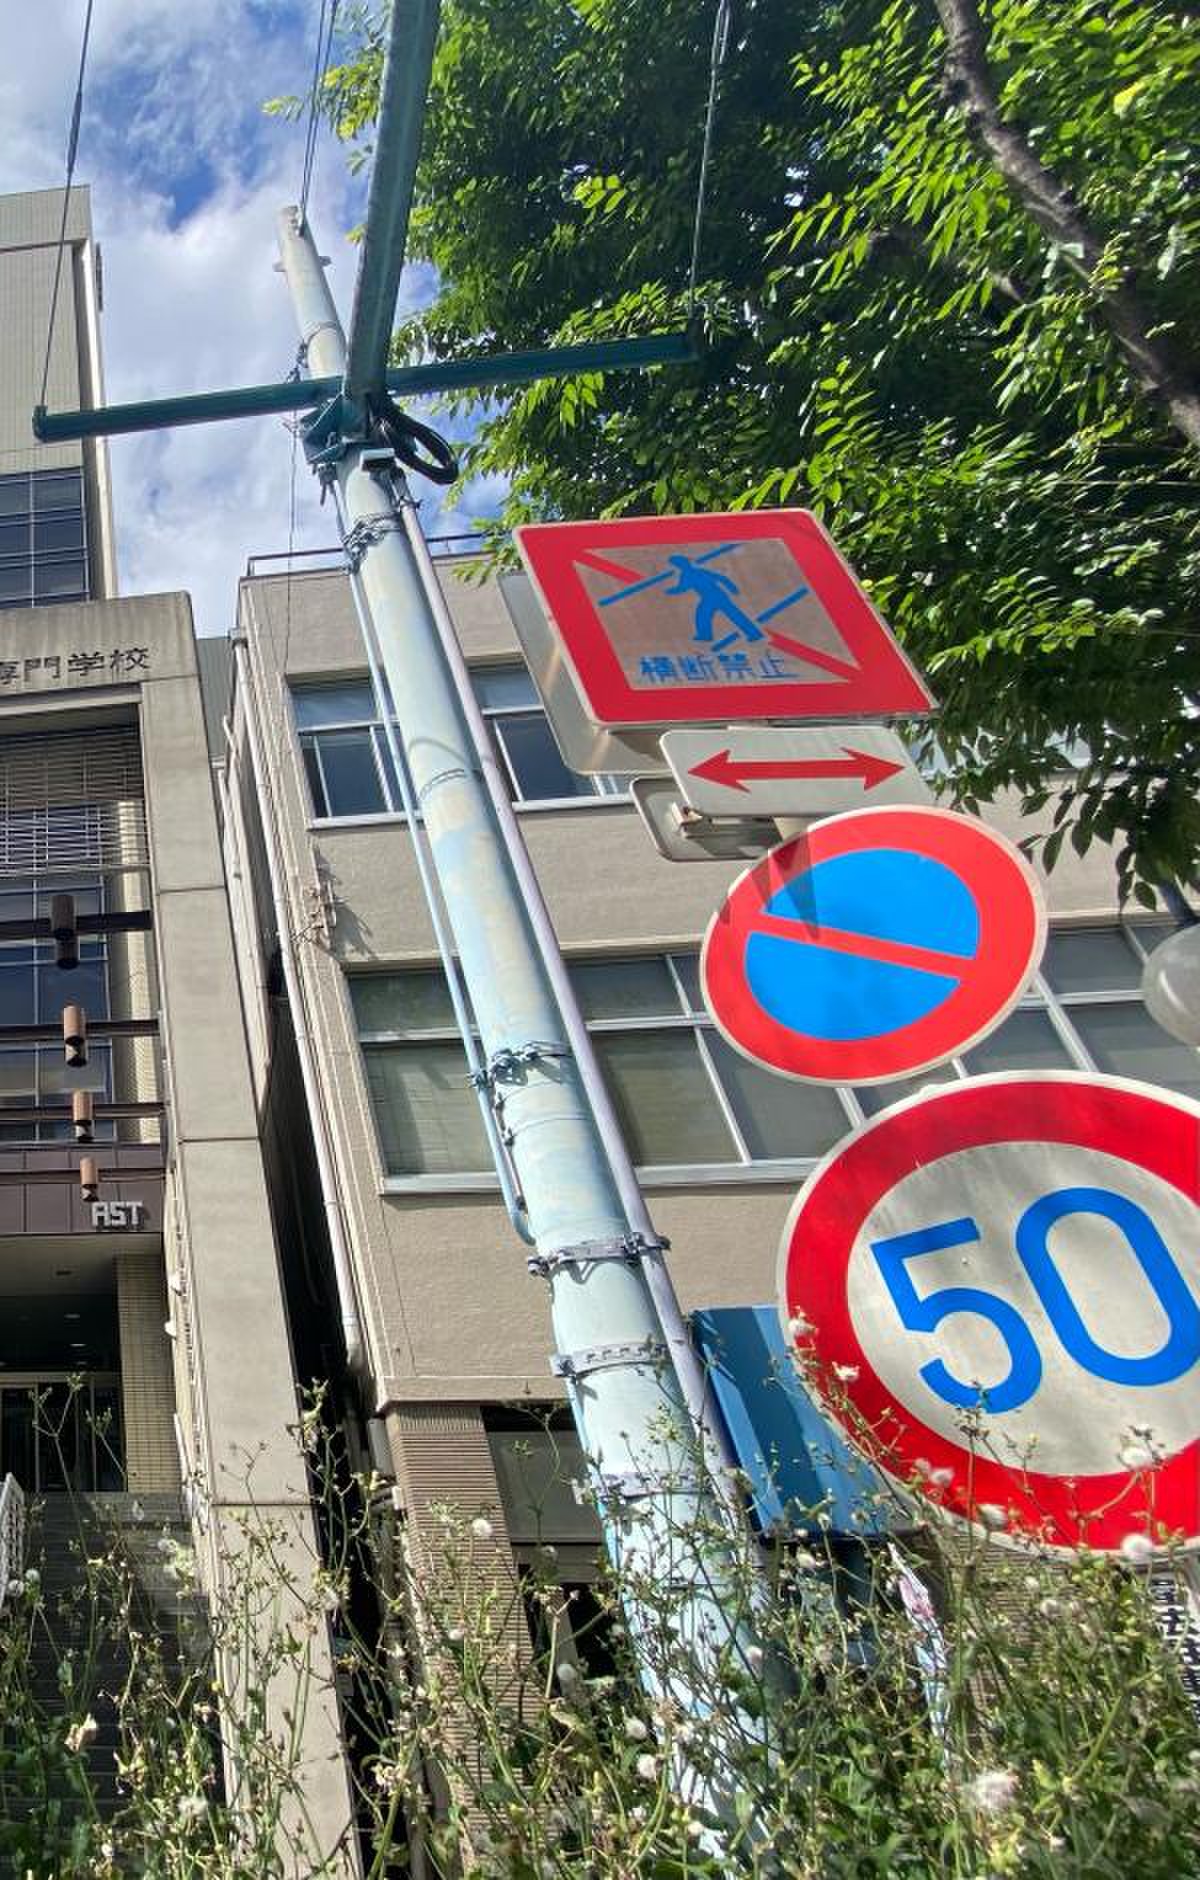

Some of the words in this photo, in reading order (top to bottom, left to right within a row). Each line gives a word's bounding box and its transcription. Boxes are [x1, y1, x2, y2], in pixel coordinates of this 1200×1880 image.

[640, 650, 800, 683] 横断禁止
[92, 1201, 143, 1226] AST
[871, 1187, 1200, 1414] 50
